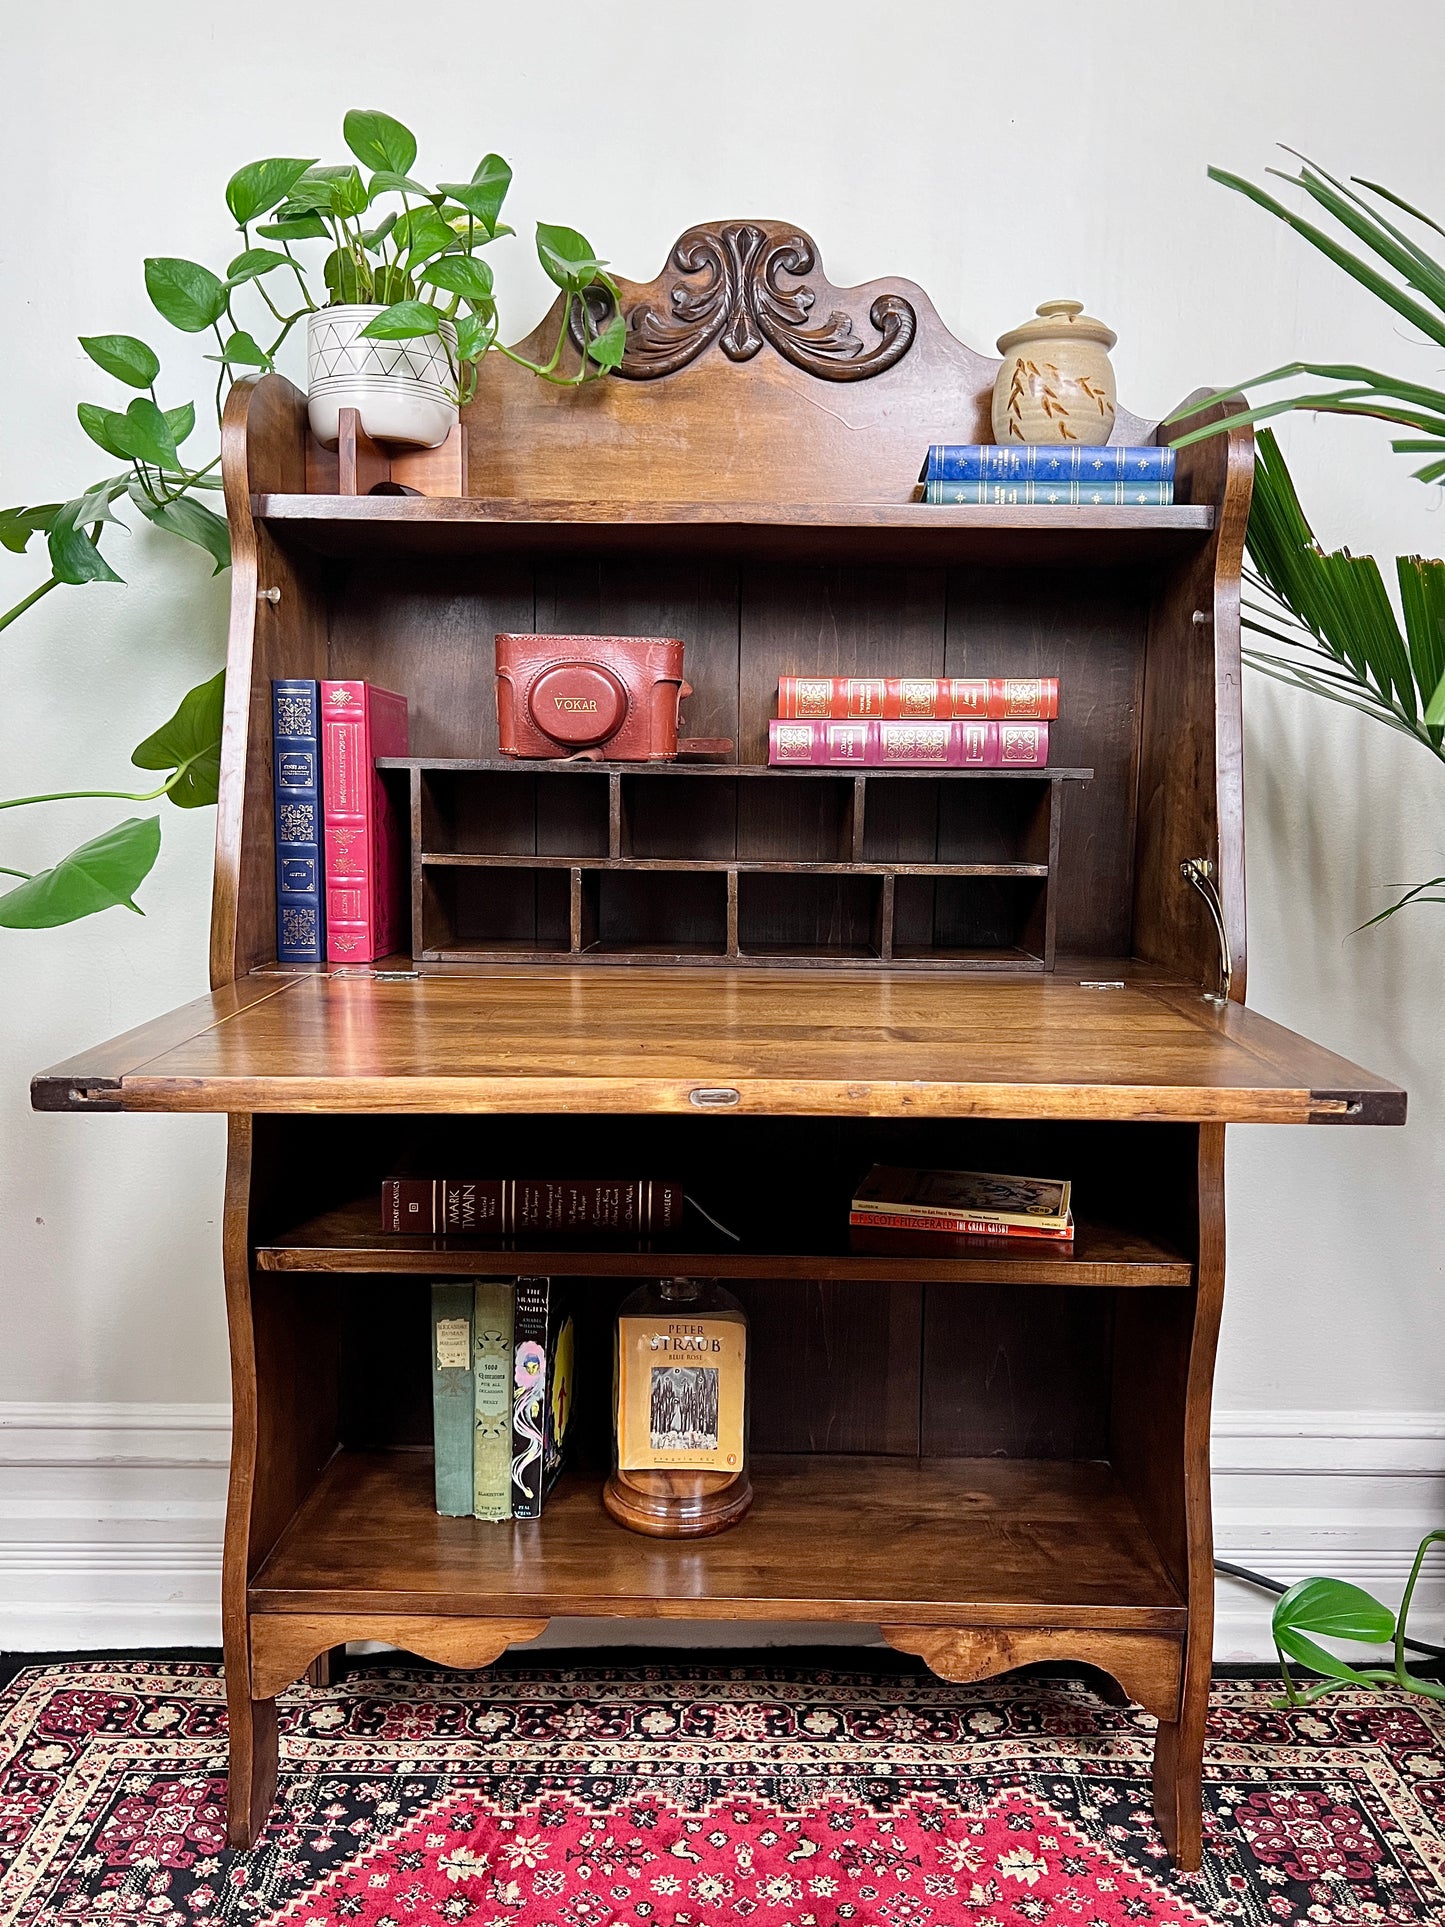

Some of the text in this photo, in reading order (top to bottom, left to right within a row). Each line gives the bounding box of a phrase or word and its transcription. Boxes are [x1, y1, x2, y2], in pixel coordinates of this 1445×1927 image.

[554, 698, 597, 712] VOKAR
[531, 1190, 539, 1207] Sawyer
[602, 1189, 610, 1202] King
[611, 1189, 619, 1205] Court
[625, 1185, 633, 1203] Works
[449, 1190, 460, 1223] MARK
[462, 1185, 476, 1228] TWAIN
[569, 1201, 577, 1215] Prince
[578, 1195, 587, 1211] Pauper
[593, 1188, 601, 1220] Connecticut
[625, 1204, 633, 1220] Other
[868, 1216, 896, 1226] SCOTT
[900, 1218, 954, 1229] FITZGERALD
[957, 1222, 1009, 1234] THE GREAT GATSBY
[668, 1324, 704, 1335] PETER
[650, 1337, 721, 1353] STRAUB
